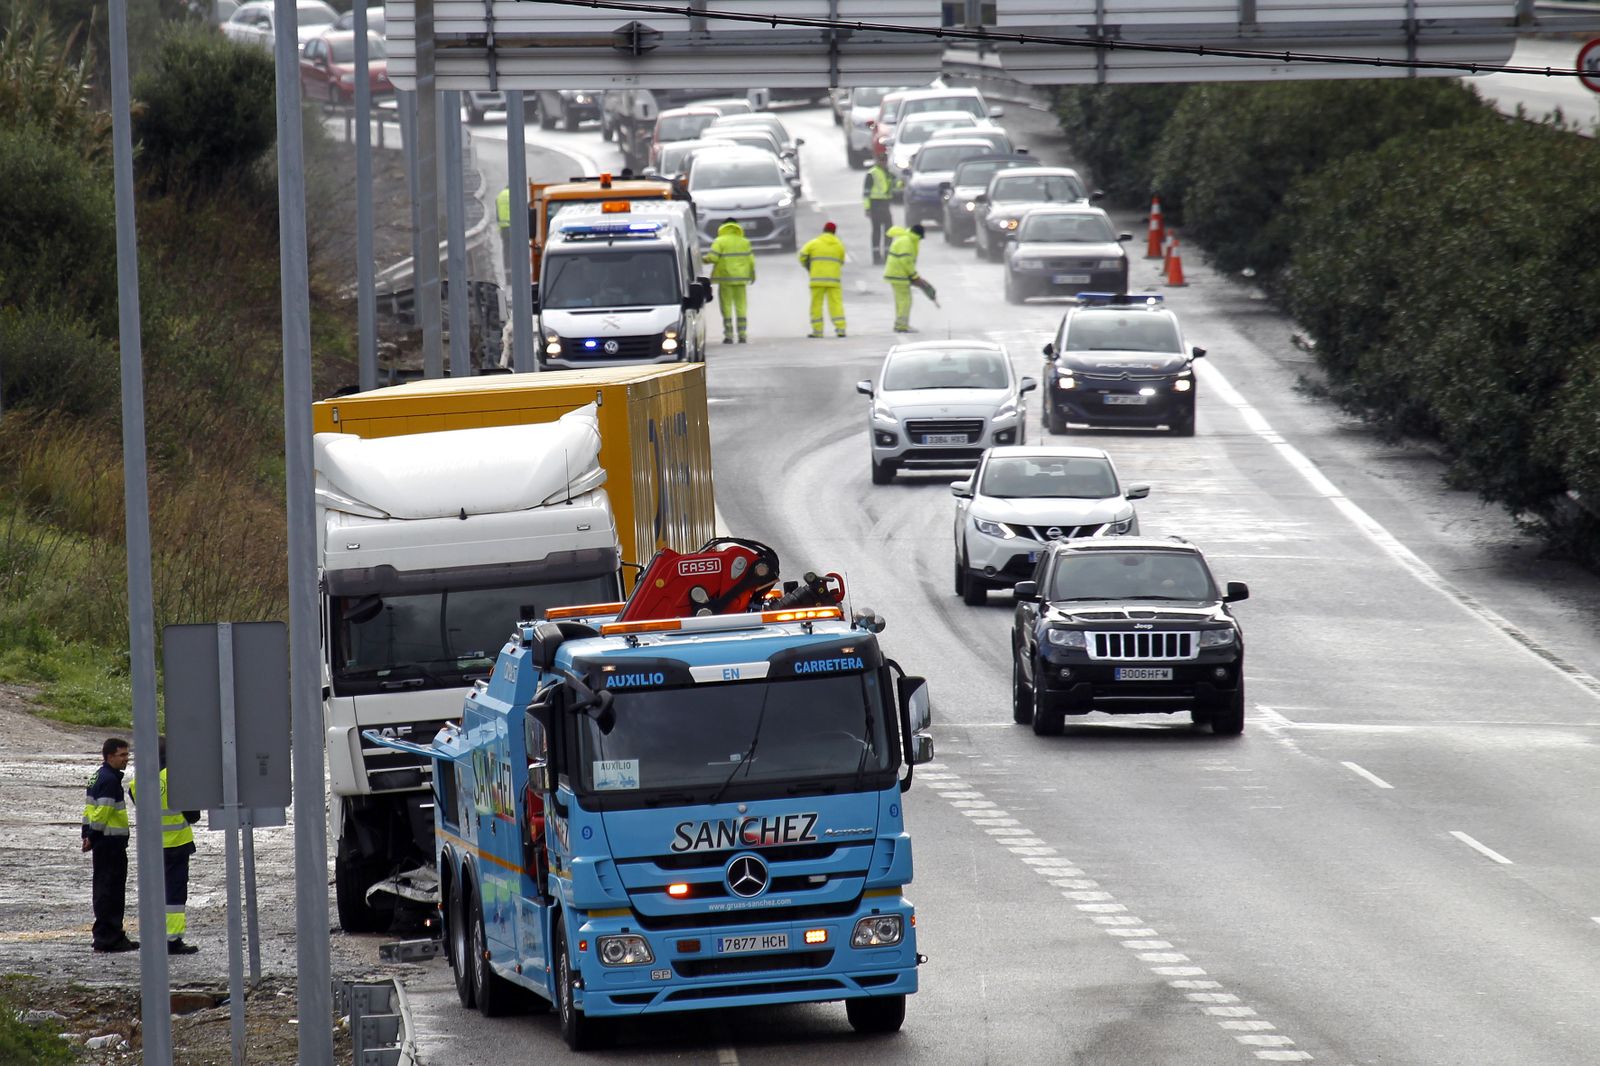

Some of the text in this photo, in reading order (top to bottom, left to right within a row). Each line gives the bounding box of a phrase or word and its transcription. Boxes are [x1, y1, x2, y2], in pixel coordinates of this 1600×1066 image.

[682, 561, 718, 573] FASSI
[606, 657, 864, 688] AUXILIO EN CARRETERA
[363, 726, 412, 739] DAF
[600, 761, 631, 771] AUXILIO
[670, 813, 818, 852] SANCHEZ
[708, 897, 792, 911] www.gruas-sanchez.com
[725, 935, 787, 951] 7877 HCH
[653, 970, 670, 980] SP
